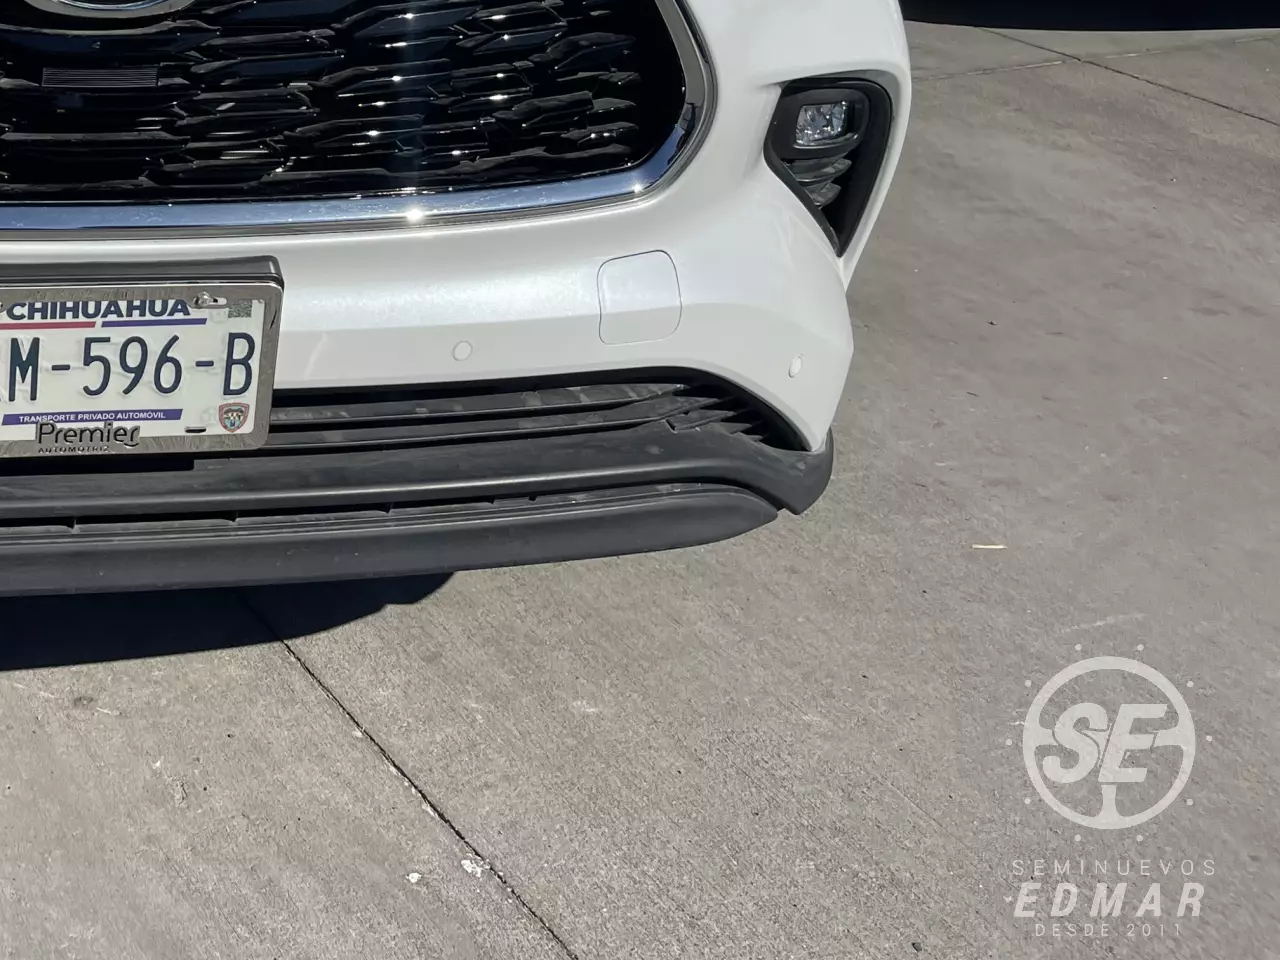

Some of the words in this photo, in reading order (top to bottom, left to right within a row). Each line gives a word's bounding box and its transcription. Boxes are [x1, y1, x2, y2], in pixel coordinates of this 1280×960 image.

[6, 299, 191, 321] CHIHUAHUA
[19, 413, 76, 422] TRANSPORTE
[78, 412, 116, 421] PRIVADO
[117, 410, 166, 420] AUTOMÓVIL
[37, 422, 140, 448] Premier
